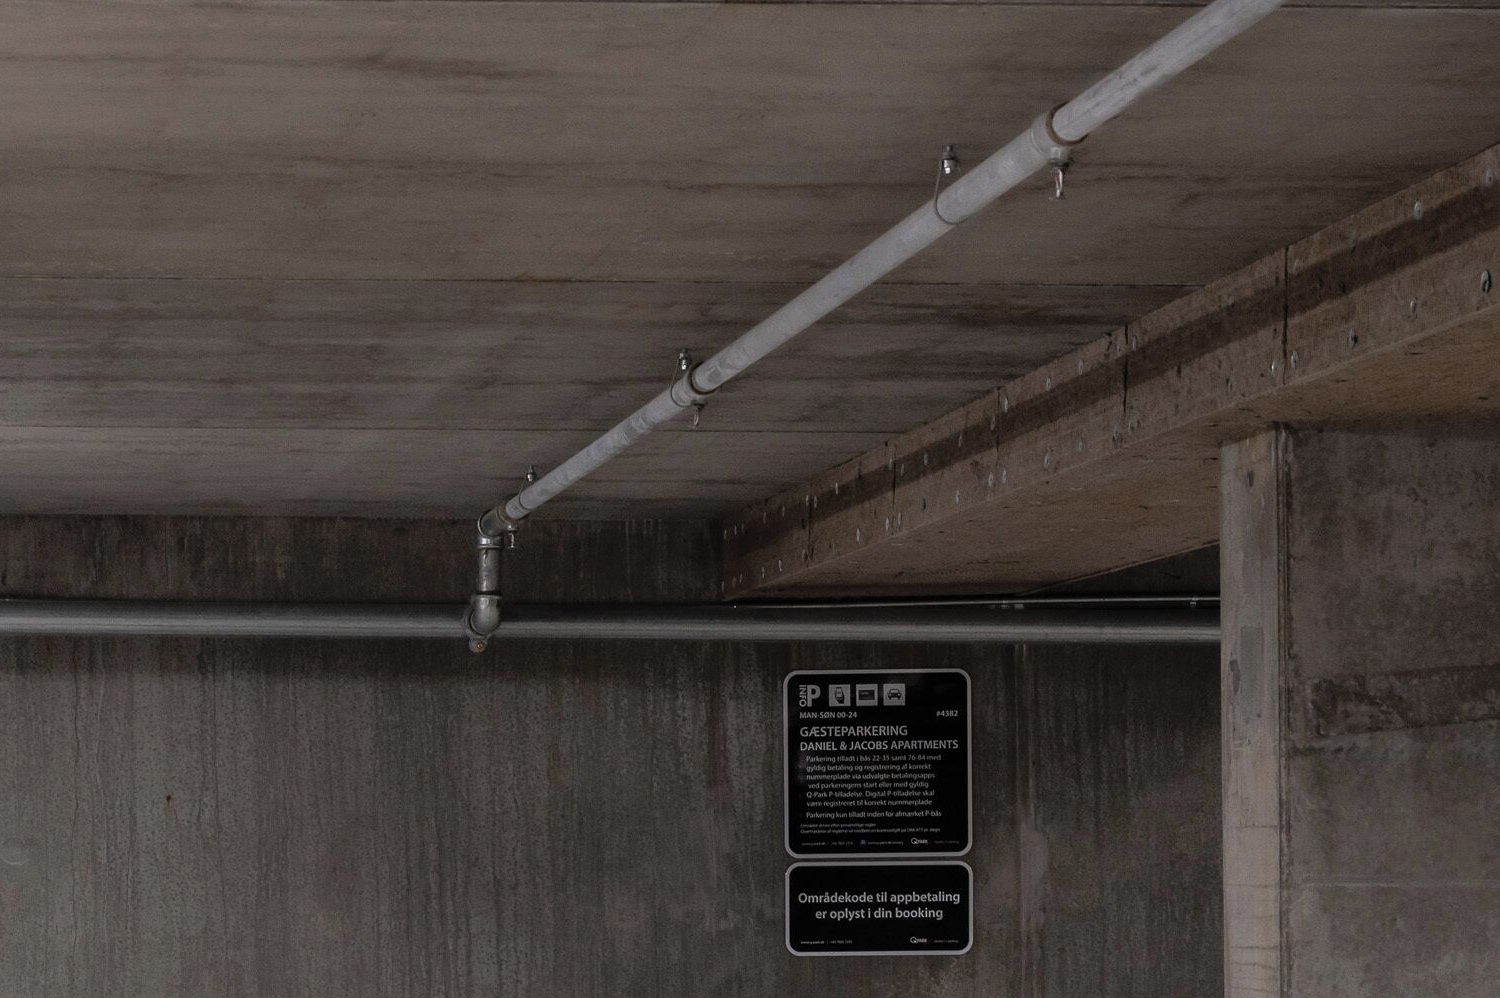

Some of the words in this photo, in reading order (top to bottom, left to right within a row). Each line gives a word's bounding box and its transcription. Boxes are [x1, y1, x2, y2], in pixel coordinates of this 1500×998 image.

[807, 685, 820, 707] P
[800, 726, 908, 737] GÆSTEPARKERING
[800, 741, 837, 751] DANIEL
[840, 741, 848, 750] &
[849, 740, 888, 750] JACOBS
[891, 740, 959, 750] APARTMENTS
[798, 892, 873, 903] Områdekode
[876, 892, 887, 902] til
[890, 891, 960, 904] appbetaling
[815, 910, 827, 919] er
[830, 909, 865, 921] oplyst
[868, 908, 871, 918] i
[874, 908, 892, 918] din
[896, 907, 943, 920] booking
